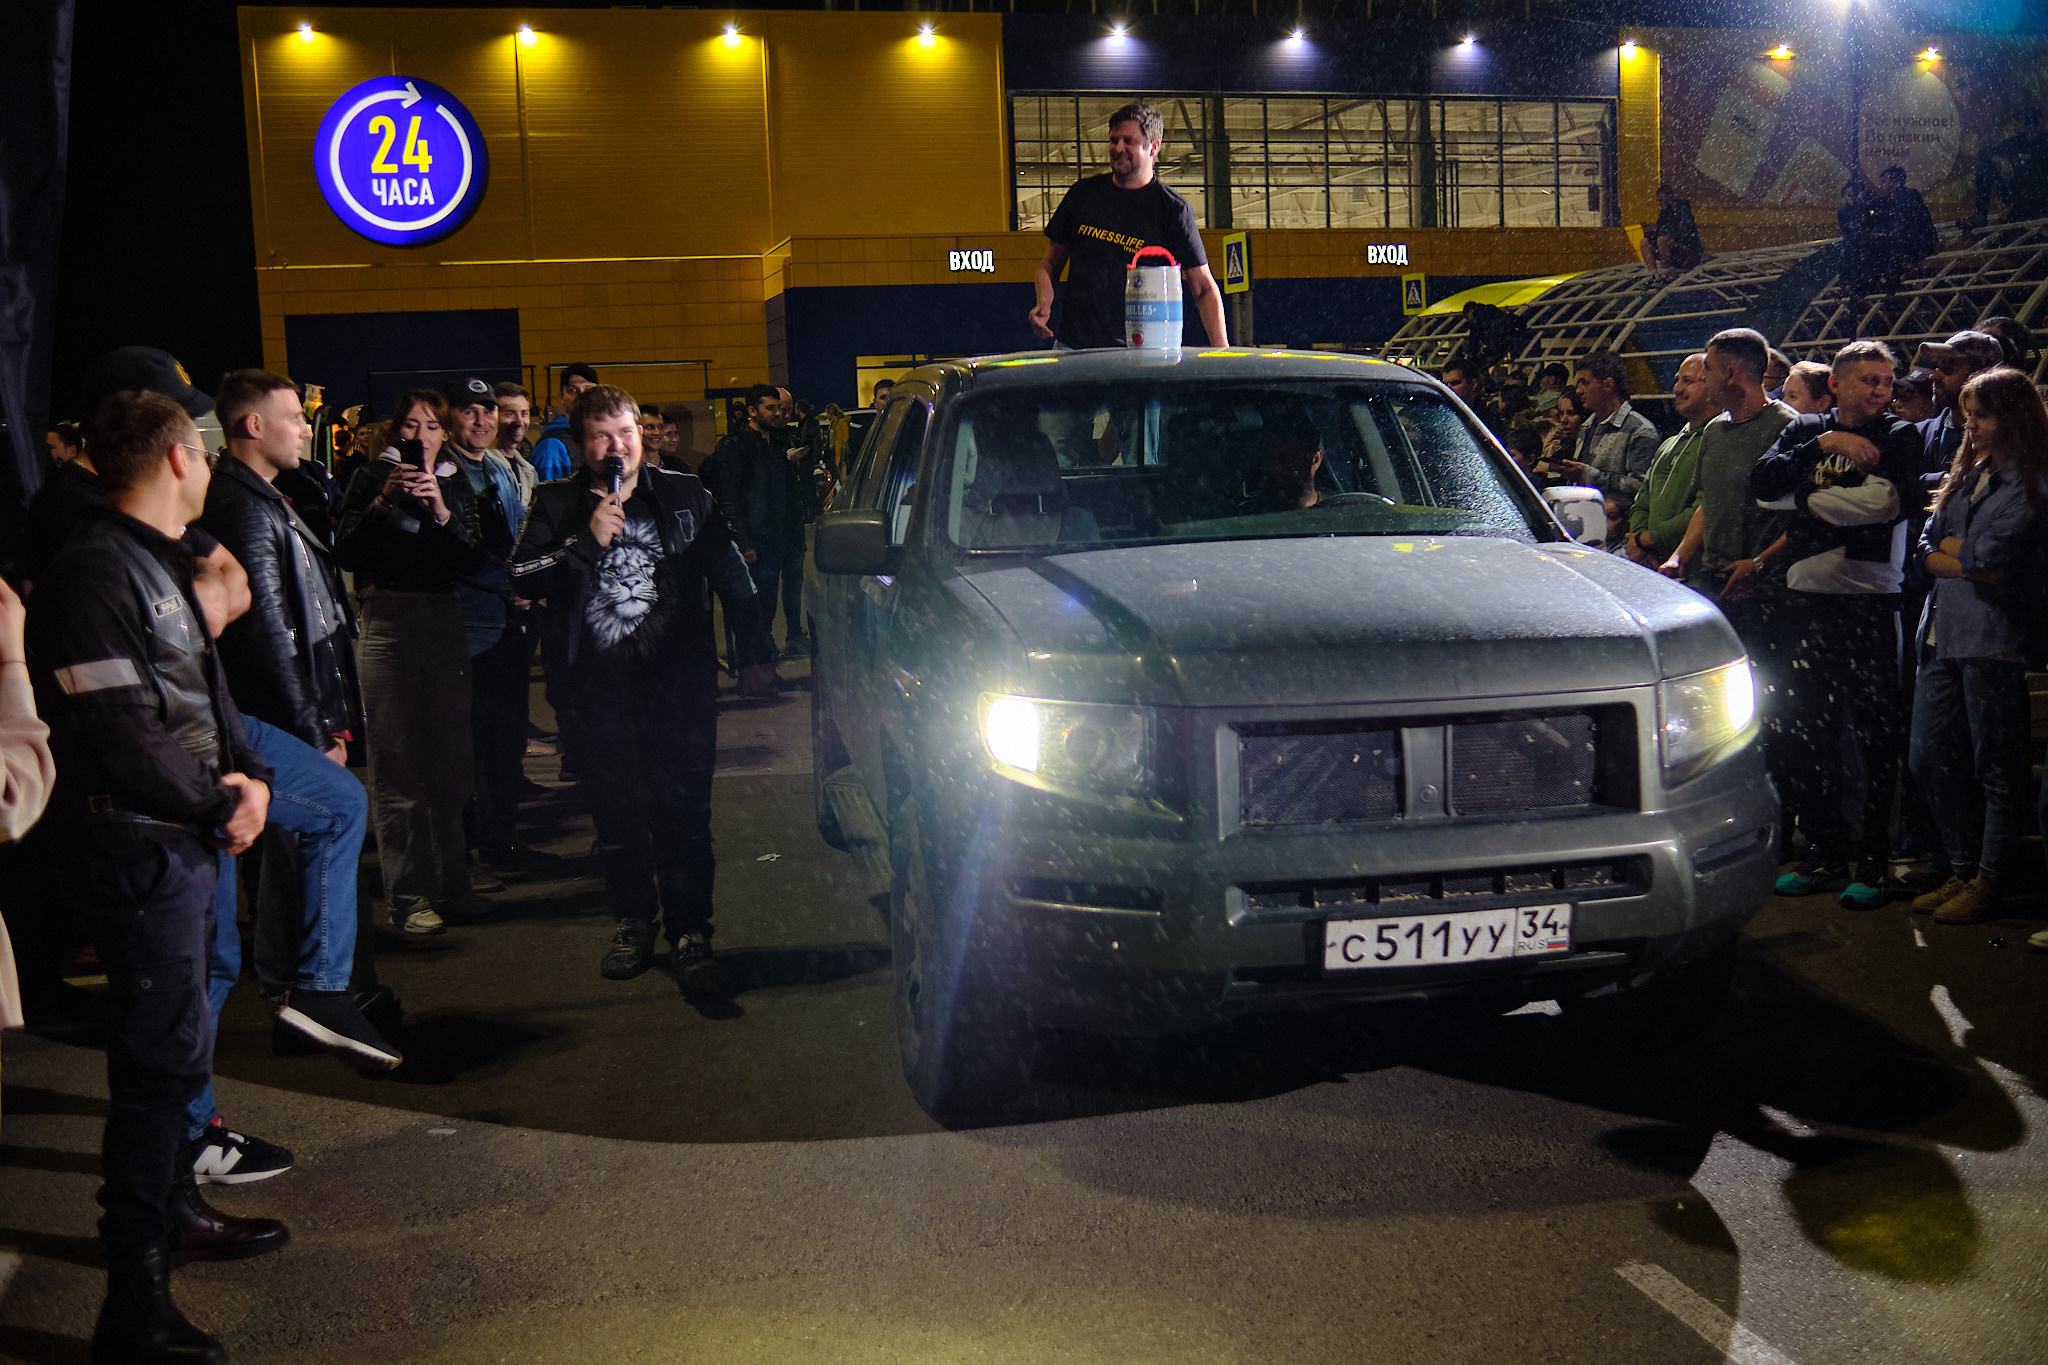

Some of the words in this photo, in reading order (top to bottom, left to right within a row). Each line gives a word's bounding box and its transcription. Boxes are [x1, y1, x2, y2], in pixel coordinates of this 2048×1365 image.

[368, 115, 433, 174] 24
[371, 177, 435, 206] ЧАСА
[1077, 224, 1145, 249] FITNESSLIFE
[949, 249, 995, 273] ВХОД
[1367, 243, 1409, 266] ВХОД
[1521, 908, 1559, 938] 34
[1517, 939, 1546, 950] RUS
